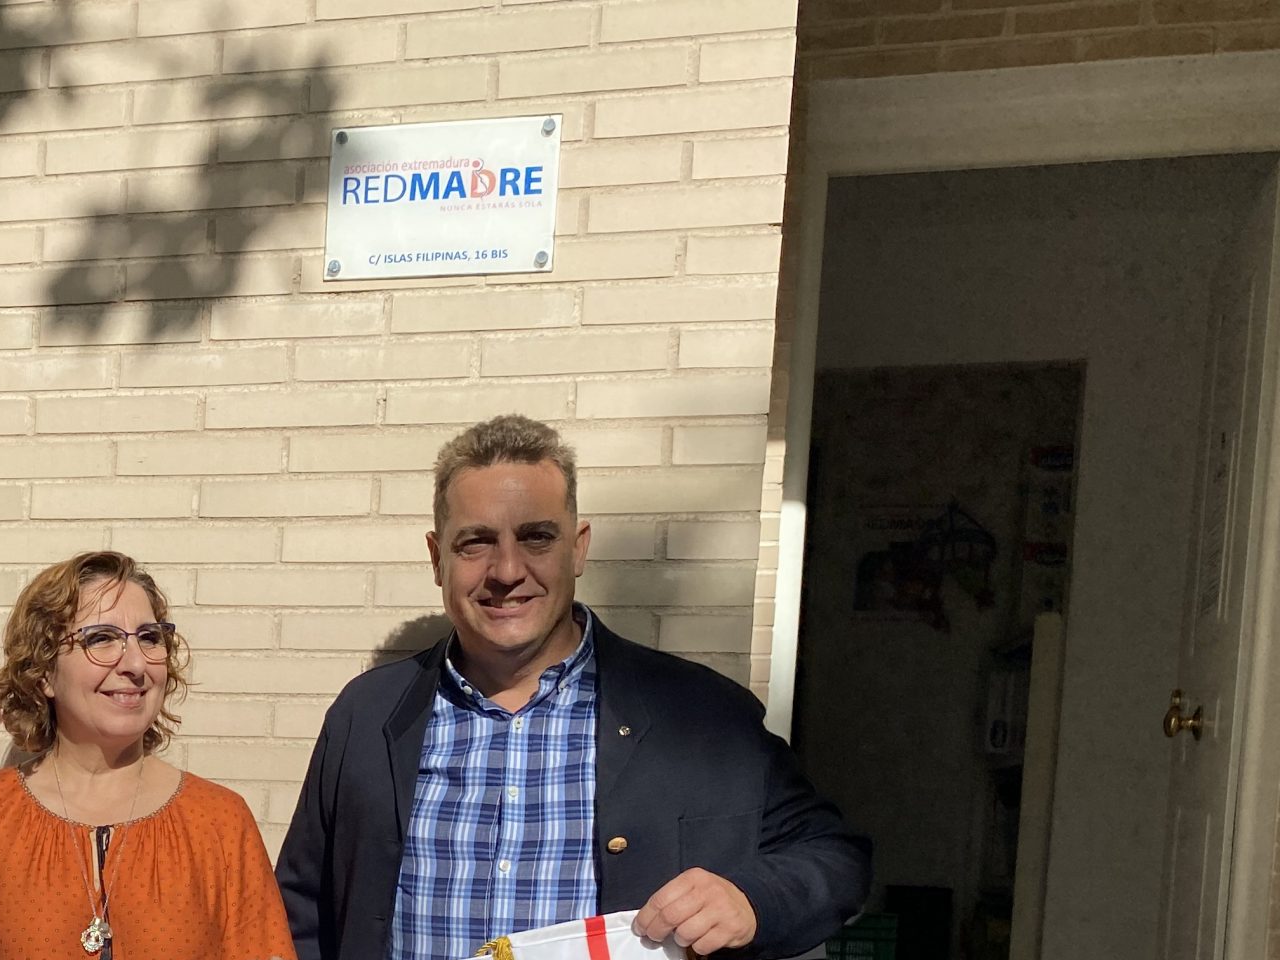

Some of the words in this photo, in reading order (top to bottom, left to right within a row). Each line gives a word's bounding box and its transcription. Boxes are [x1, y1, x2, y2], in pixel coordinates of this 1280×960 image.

[344, 160, 398, 175] asociación
[401, 156, 470, 171] extremadura
[342, 165, 543, 205] REDMADRE
[440, 204, 472, 212] NUNCA
[518, 201, 542, 209] SOLA
[369, 254, 381, 265] C/
[384, 253, 413, 264] ISLAS
[416, 250, 471, 262] FILIPINAS,
[475, 250, 487, 260] 16
[491, 249, 508, 259] BIS
